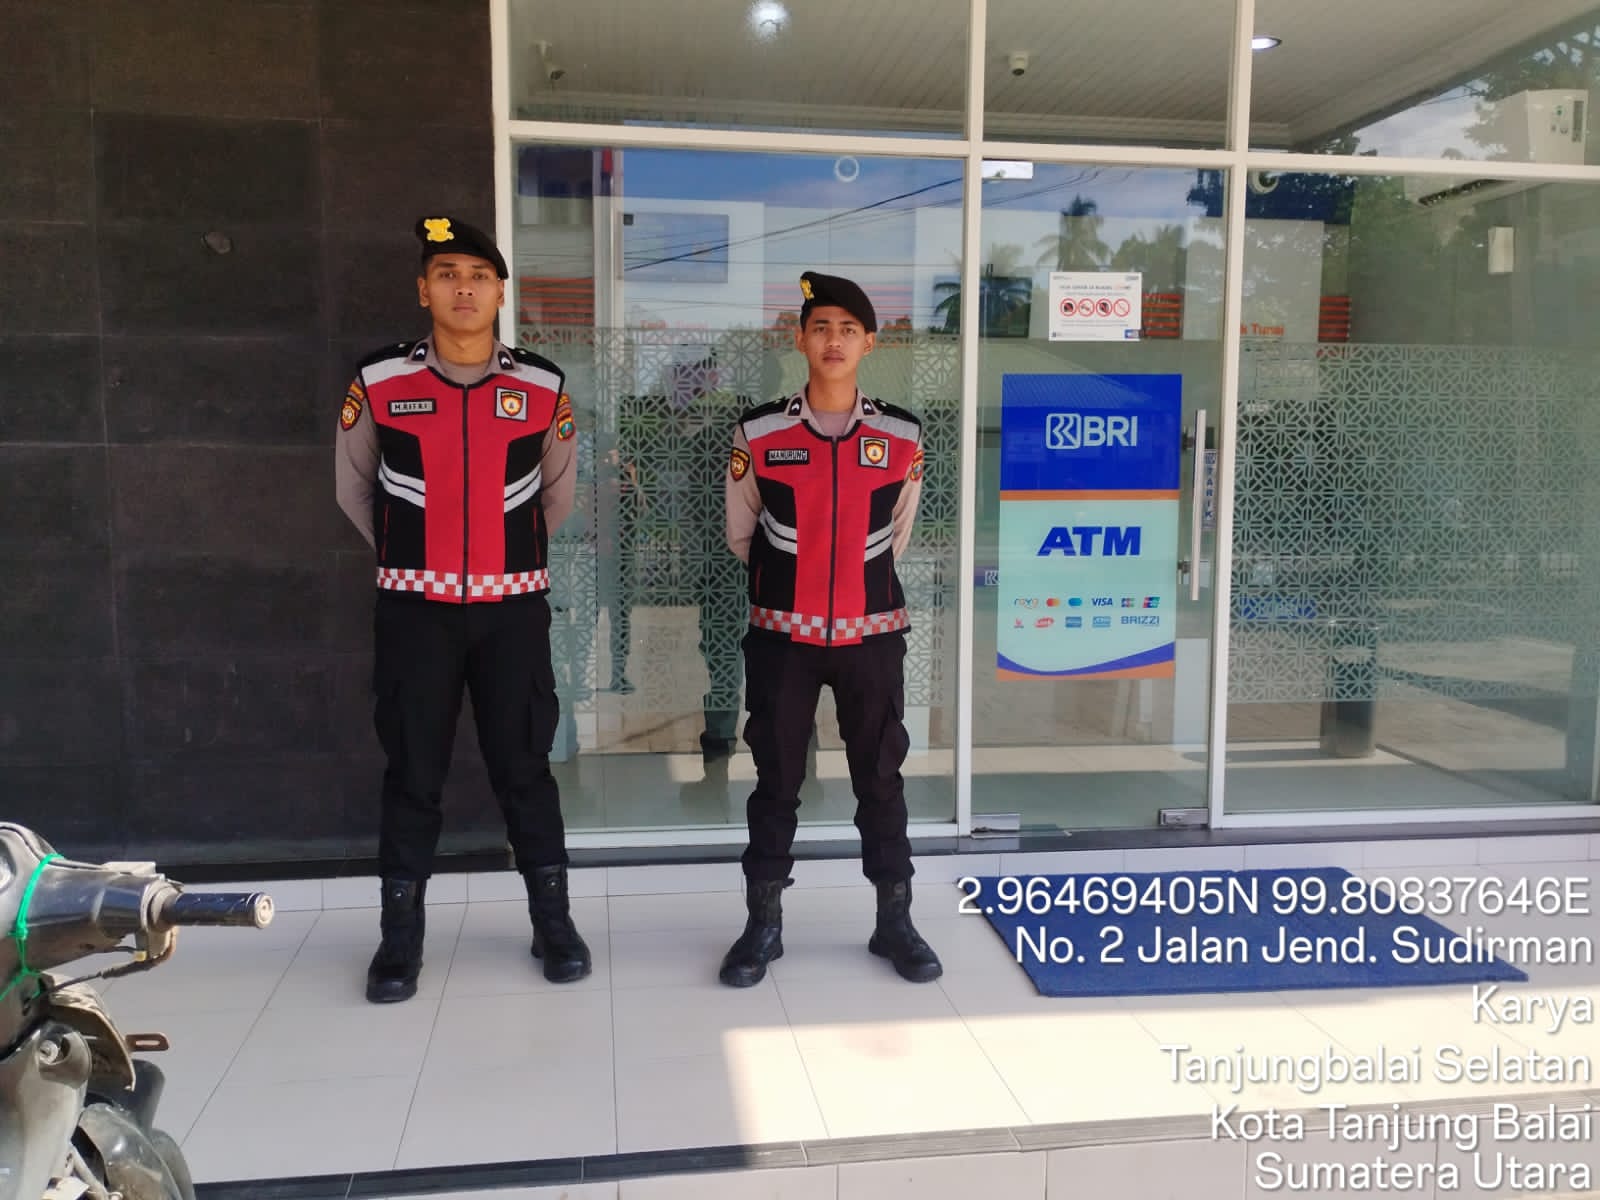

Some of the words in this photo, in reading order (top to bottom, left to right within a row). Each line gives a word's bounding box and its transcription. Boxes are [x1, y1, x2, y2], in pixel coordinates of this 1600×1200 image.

[1083, 415, 1138, 447] BRI
[1037, 526, 1142, 556] ATM
[1091, 597, 1113, 607] VISA
[1121, 615, 1160, 625] BRIZZI
